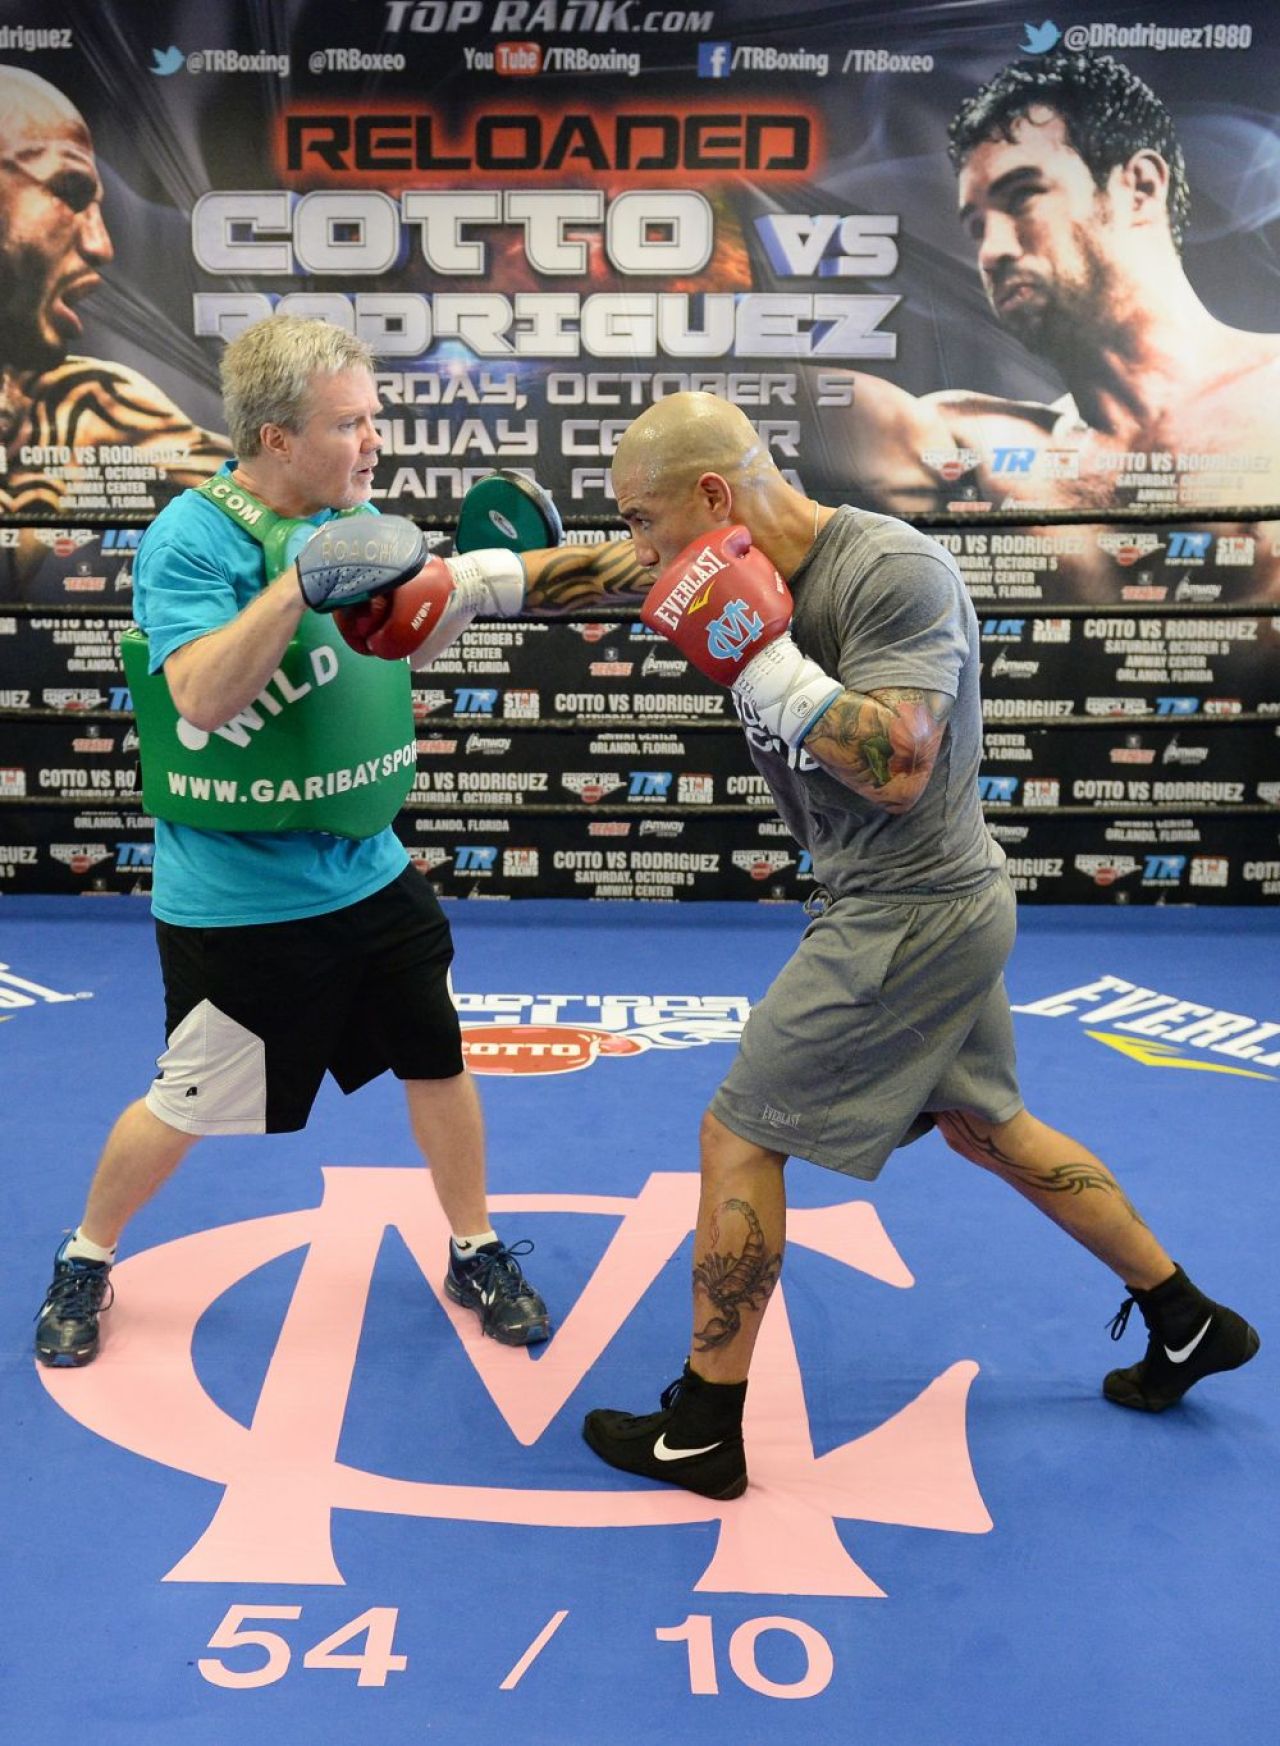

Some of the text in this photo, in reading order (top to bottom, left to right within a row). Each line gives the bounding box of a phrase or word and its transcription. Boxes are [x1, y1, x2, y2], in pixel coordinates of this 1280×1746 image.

[384, 1, 481, 31] TOP
[1063, 23, 1252, 50] @DRodriguez1980
[186, 49, 290, 76] @TRBoxing
[308, 49, 406, 74] @TRBoxeo
[543, 46, 641, 76] /TRBoxing
[732, 46, 829, 76] /TRBoxing
[842, 50, 934, 74] /TRBoxeo
[286, 114, 811, 171] RELOADED
[192, 190, 900, 277] COTTO VS
[547, 372, 799, 405] OCTOBER
[818, 375, 855, 407] 5
[20, 445, 71, 466] COTTO
[75, 445, 97, 465] VS
[965, 535, 988, 554] VS
[1168, 533, 1212, 558] TR
[653, 546, 730, 631] EVERLAST
[462, 632, 514, 646] OCTOBER
[1084, 618, 1259, 640] COTTO VS RODRIGUEZ
[462, 648, 503, 660] CENTER
[467, 661, 511, 673] FLORIDA
[453, 688, 498, 712] TR
[555, 693, 606, 713] COTTO
[608, 694, 630, 713] VS
[633, 694, 726, 714] RODRIGUEZ
[982, 699, 1075, 719] RODRIGUEZ
[589, 741, 686, 756] ORLANDO, FLORIDA
[39, 769, 86, 788] COTTO
[91, 769, 112, 788] VS
[433, 772, 455, 790] VS
[458, 772, 549, 791] RODRIGUEZ
[628, 771, 673, 796] TR
[1073, 780, 1124, 800] COTTO
[1127, 781, 1150, 800] VS
[1152, 781, 1245, 802] RODRIGUEZ
[415, 819, 510, 833] ORLANDO, FLORIDA
[454, 846, 498, 870] TR
[553, 851, 604, 870] COTTO
[606, 852, 627, 870] VS
[630, 852, 721, 872] RODRIGUEZ
[1144, 855, 1187, 880] TR
[574, 870, 696, 886] SATURDAY, OCTOBER 5
[634, 886, 675, 897] CENTER
[197, 1603, 408, 1689] 54
[655, 1614, 834, 1699] 10
